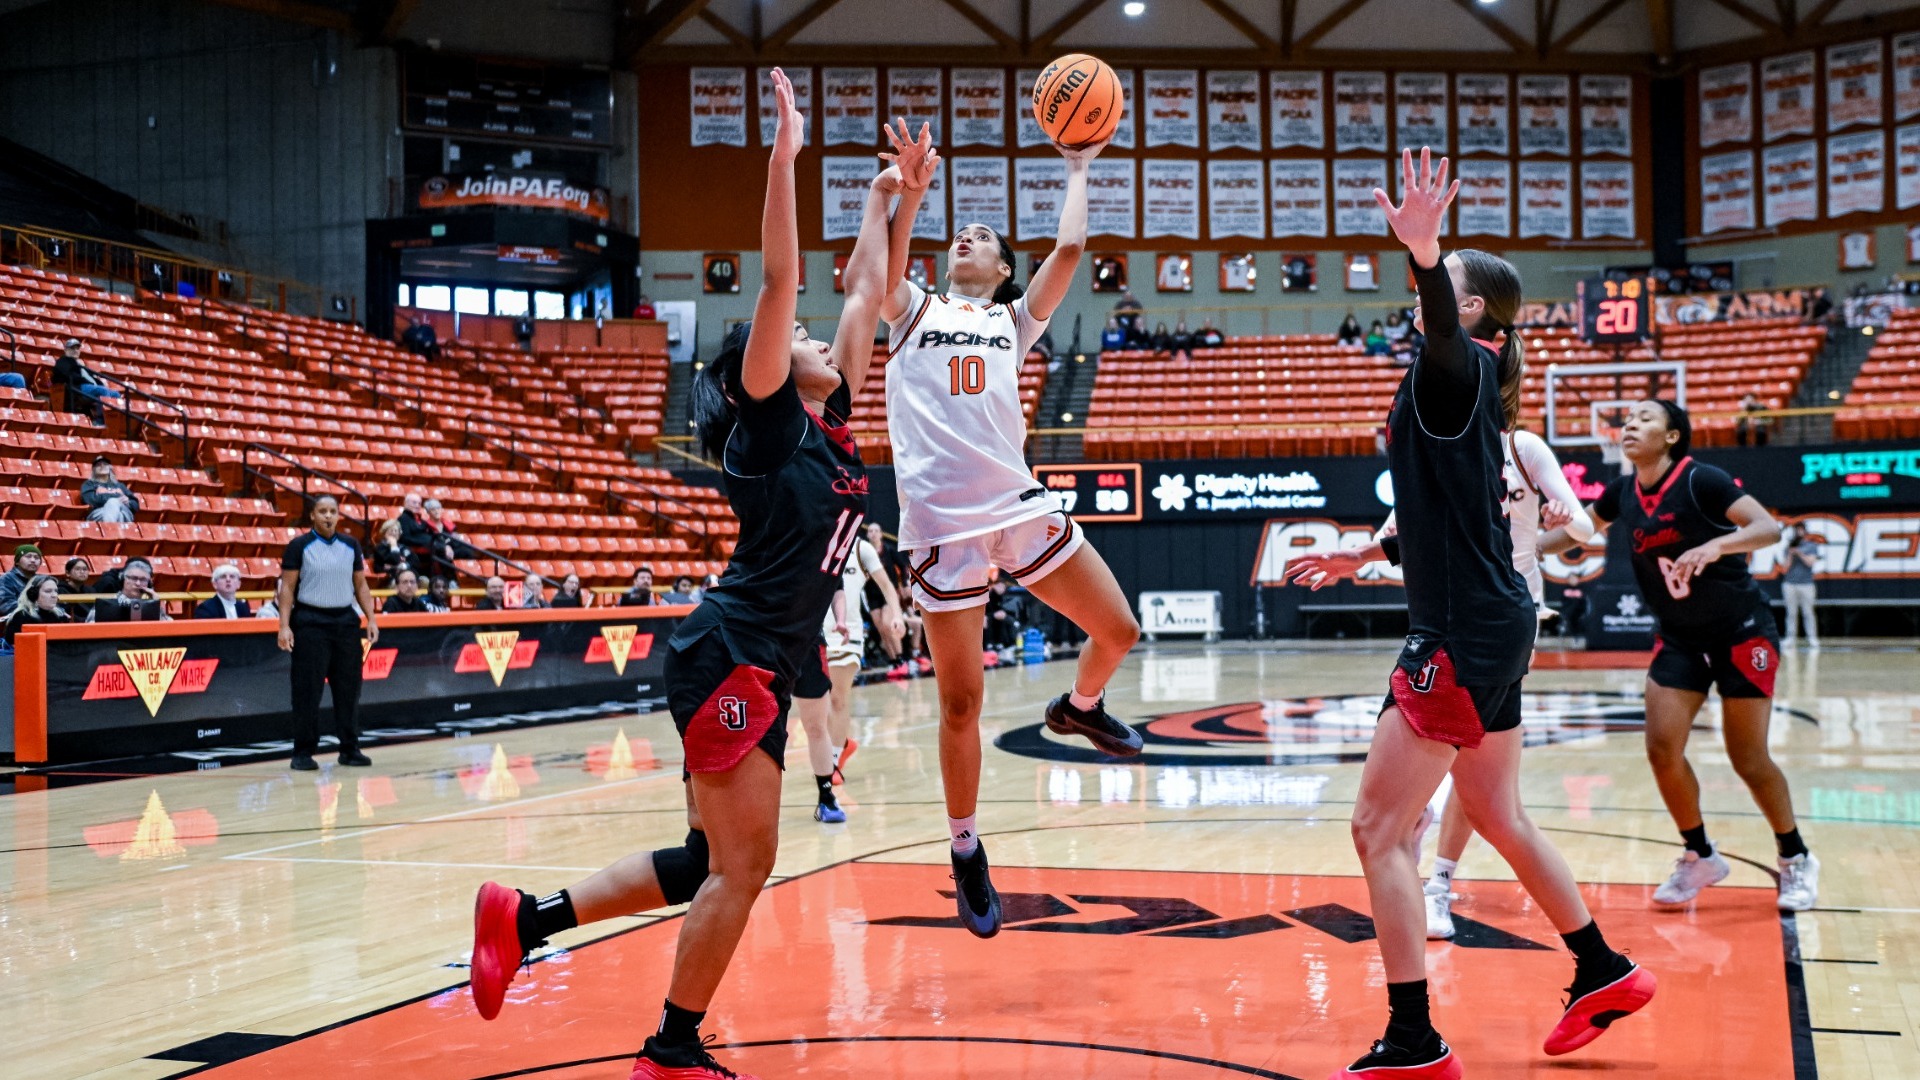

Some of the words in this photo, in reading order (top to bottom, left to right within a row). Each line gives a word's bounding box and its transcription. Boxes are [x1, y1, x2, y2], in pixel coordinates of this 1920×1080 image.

[1033, 63, 1059, 105] NCAA
[1045, 69, 1089, 124] Wilson
[956, 175, 1003, 187] PACIFIC
[1019, 179, 1066, 191] PACIFIC
[1148, 178, 1194, 189] PACIFIC
[1213, 178, 1258, 189] PACIFIC
[1275, 177, 1320, 189] PACIFIC
[1337, 177, 1382, 189] PACIFIC
[456, 175, 590, 209] JoinPAF.org
[839, 200, 863, 211] GCC
[1031, 201, 1056, 212] GCC
[711, 261, 732, 278] 40
[1596, 299, 1638, 334] 20
[917, 330, 1012, 351] PACIFIC
[947, 355, 986, 396] 10
[1047, 474, 1077, 488] PAC
[1097, 473, 1127, 487] SEA
[1195, 473, 1258, 497] Dignity
[821, 507, 865, 577] 14
[125, 650, 183, 672] J.MILANO
[366, 658, 389, 673] WARE
[97, 670, 126, 693] HARD
[180, 666, 207, 687] WARE
[718, 695, 748, 731] SU
